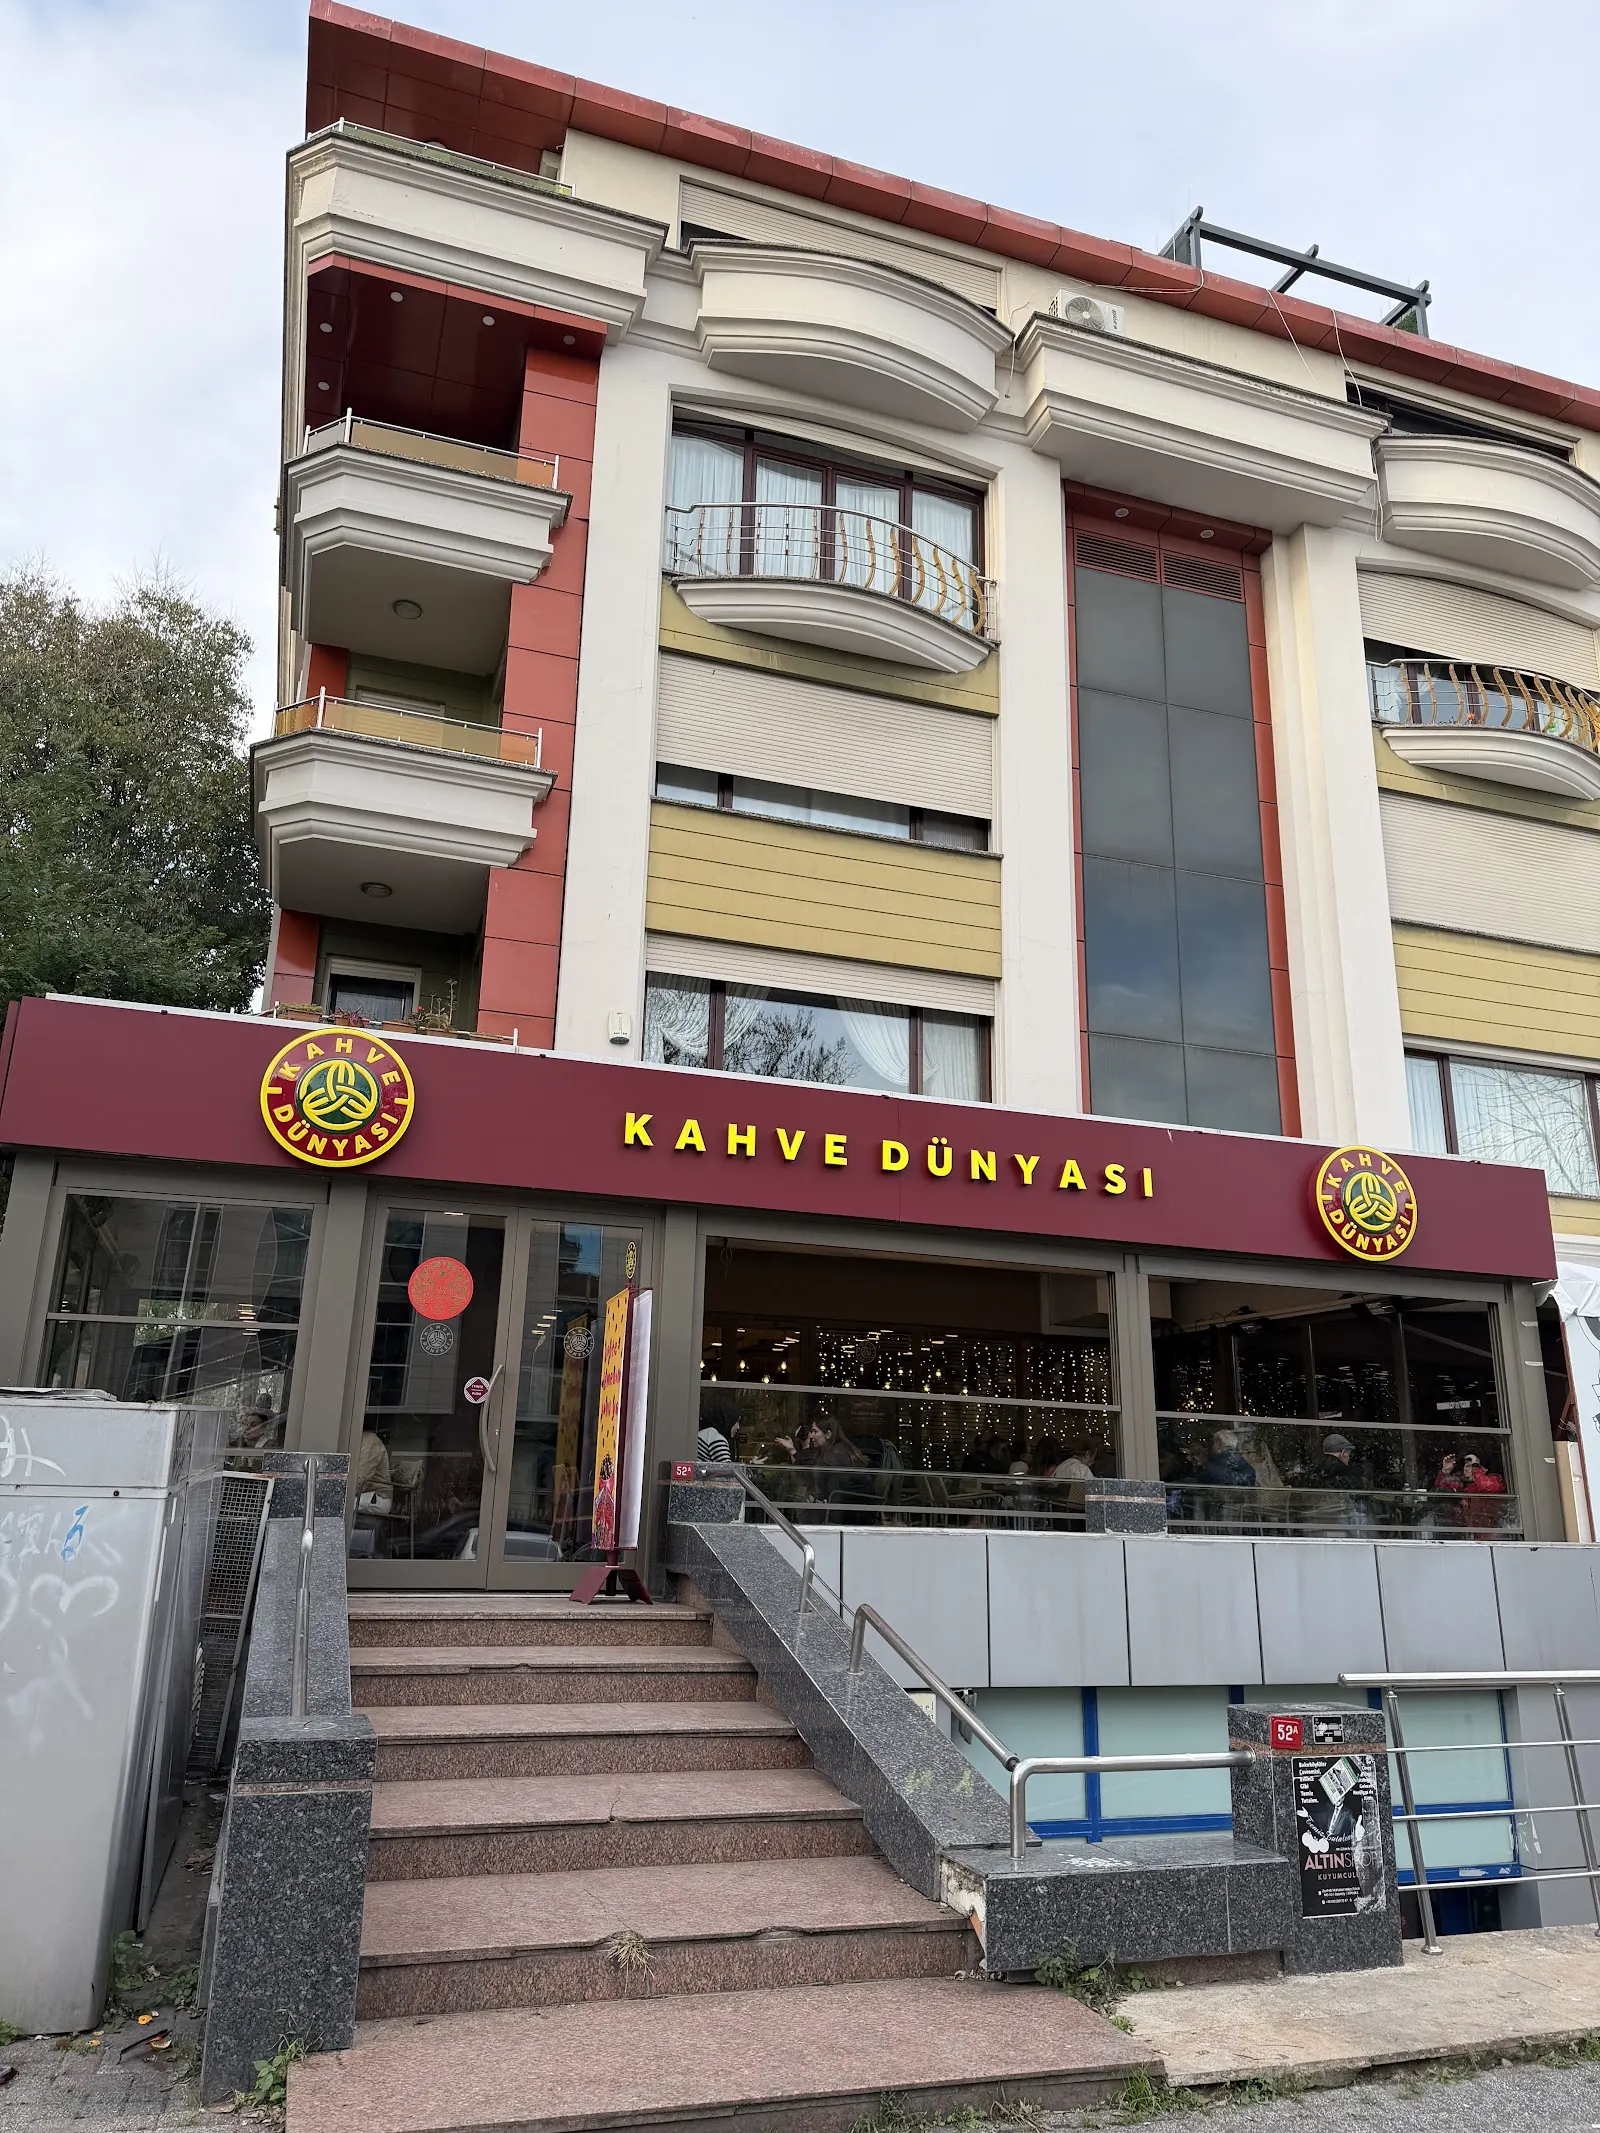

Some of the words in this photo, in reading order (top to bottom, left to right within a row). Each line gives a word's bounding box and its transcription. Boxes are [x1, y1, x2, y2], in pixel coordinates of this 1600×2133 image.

[278, 1037, 401, 1087] KAHVE
[272, 1103, 399, 1157] DÜNYASI
[623, 1111, 849, 1167] KAHVE
[880, 1136, 1154, 1198] DÜNYASI
[1325, 1152, 1408, 1194] KAHVE
[1328, 1208, 1411, 1253] DÜNYASI
[424, 1325, 451, 1337] KAHVE
[567, 1329, 592, 1340] KAHVE
